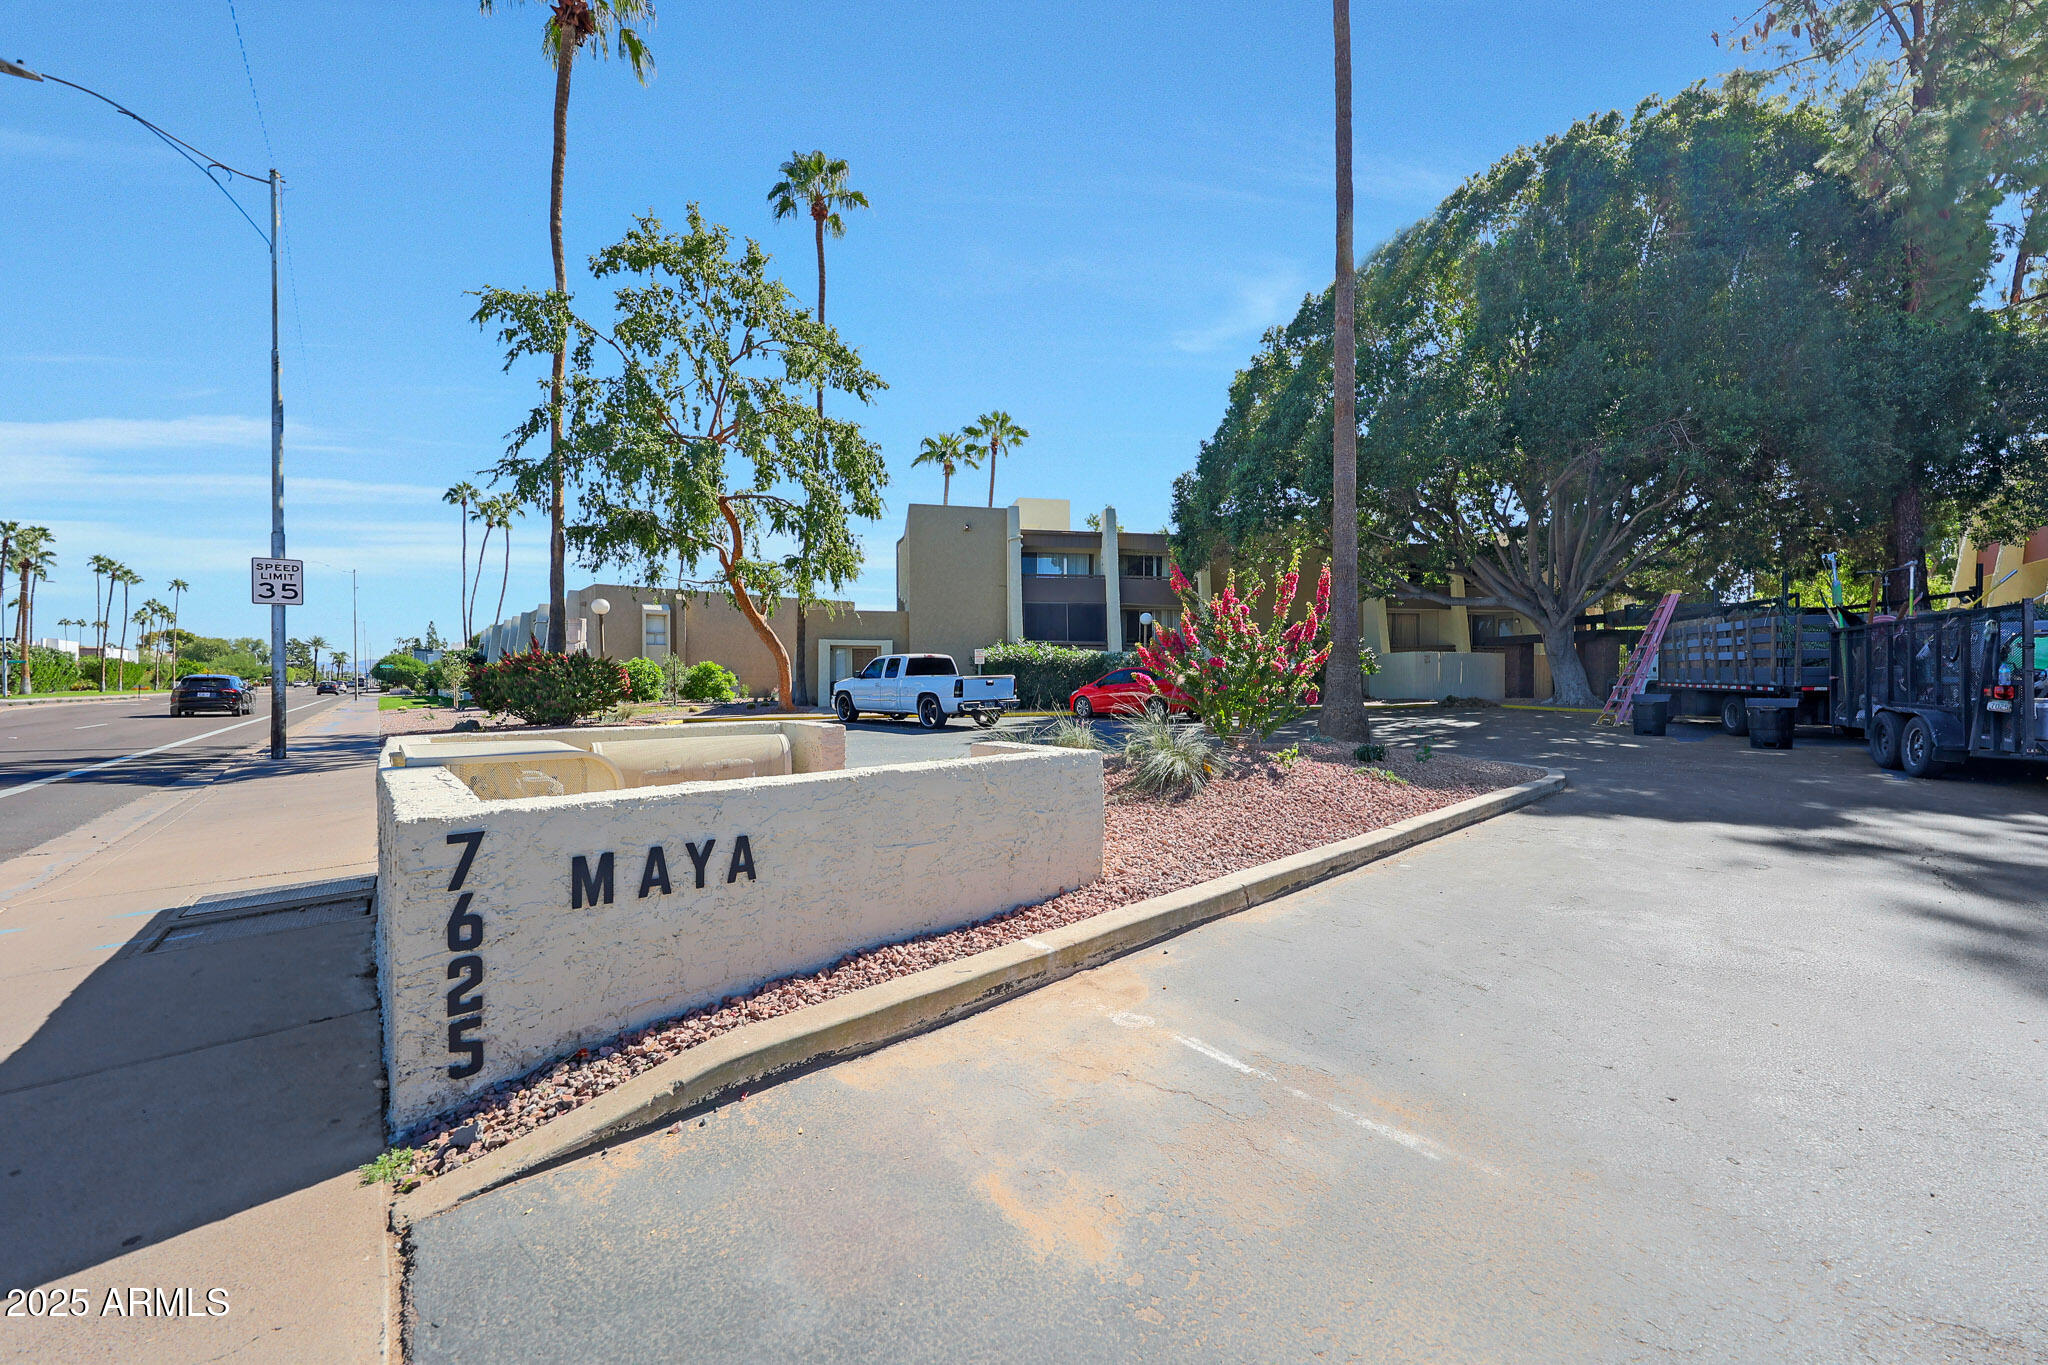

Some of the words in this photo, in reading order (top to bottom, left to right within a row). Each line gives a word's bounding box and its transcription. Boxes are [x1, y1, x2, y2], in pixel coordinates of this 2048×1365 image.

[256, 563, 300, 572] SPEED
[260, 573, 295, 581] LIMIT
[257, 582, 299, 600] 35
[571, 835, 757, 909] MAYA
[446, 831, 486, 1080] 7625
